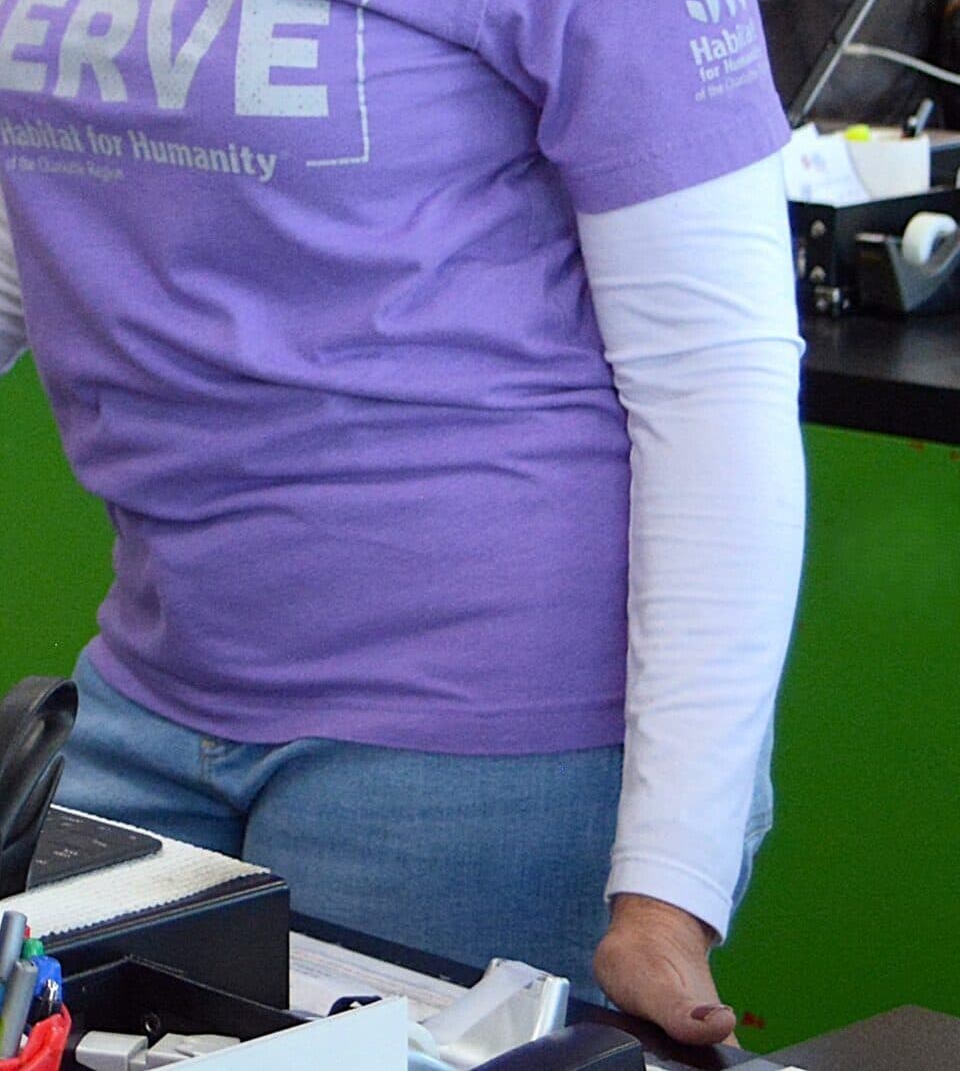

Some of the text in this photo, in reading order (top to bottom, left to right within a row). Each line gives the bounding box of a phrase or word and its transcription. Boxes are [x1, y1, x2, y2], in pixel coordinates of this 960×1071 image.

[699, 66, 721, 82] for
[86, 124, 123, 157] for
[127, 128, 278, 183] Humanity
